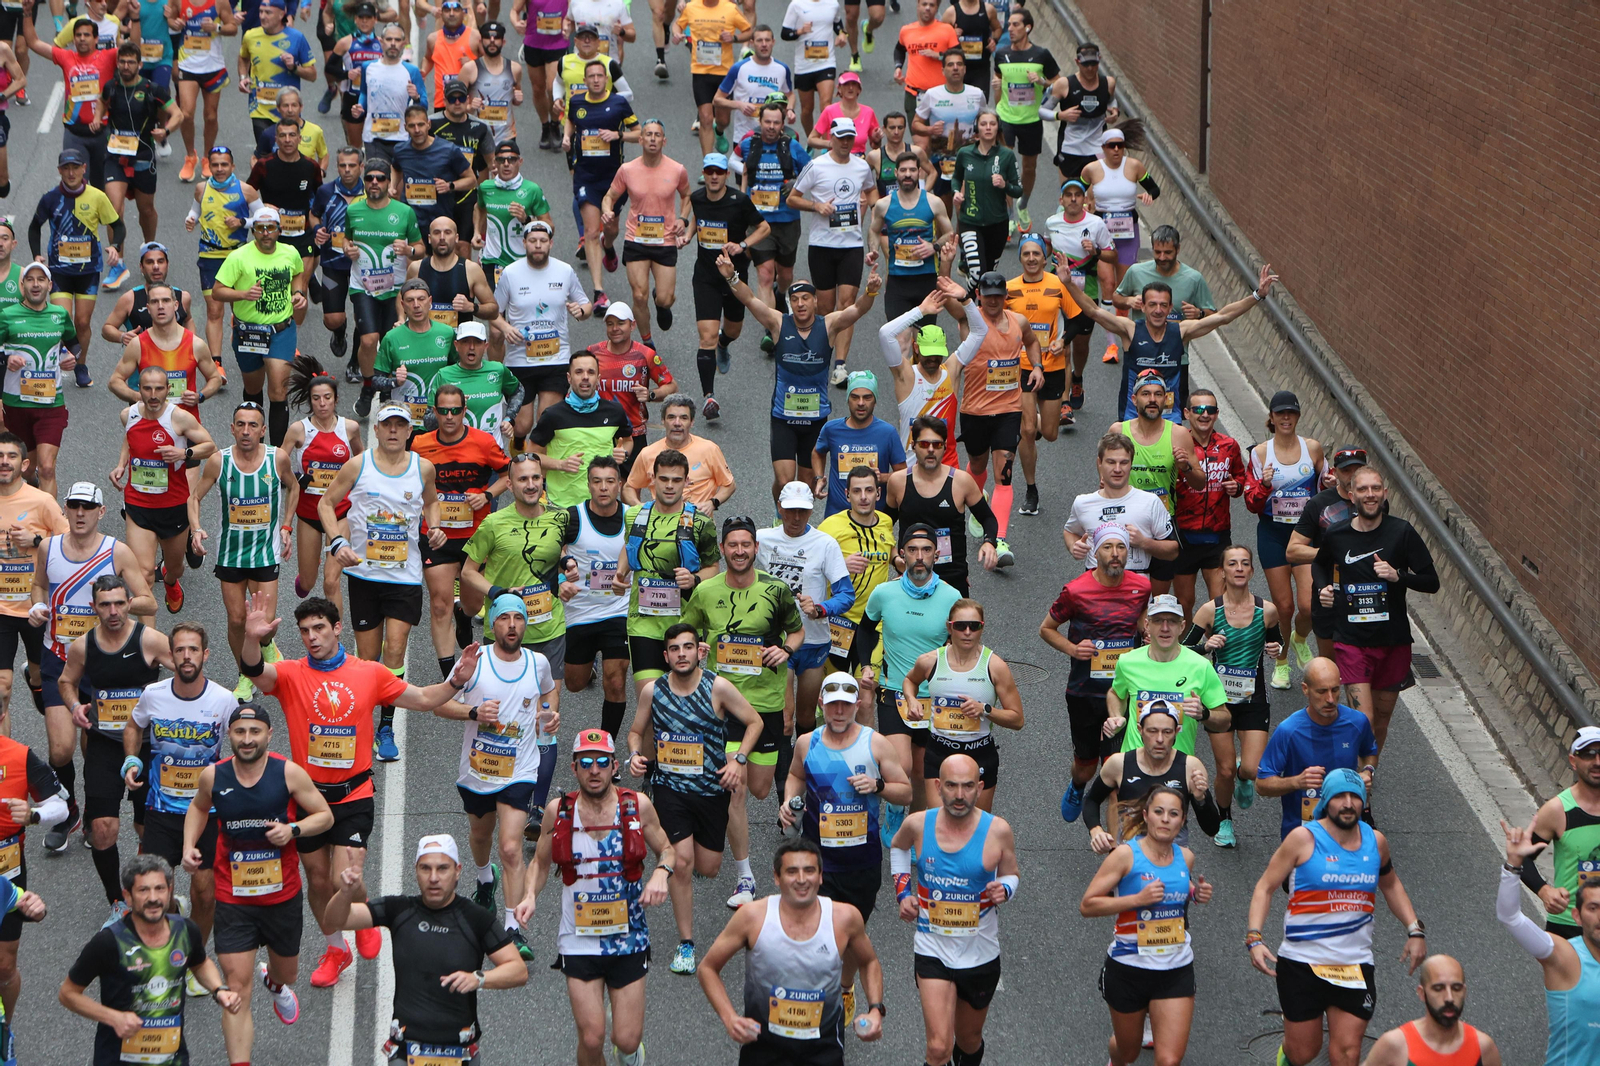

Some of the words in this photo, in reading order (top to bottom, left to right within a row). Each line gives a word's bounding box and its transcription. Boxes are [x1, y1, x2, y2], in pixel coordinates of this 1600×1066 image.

[967, 180, 977, 217] Fysical
[537, 331, 556, 339] ZURICH
[525, 584, 547, 595] ZURICH
[1107, 640, 1130, 648] ZURICH
[1228, 668, 1252, 676] ZURICH
[1225, 680, 1243, 688] 10145
[110, 690, 137, 698] ZURICH
[672, 734, 698, 742] ZURICH
[320, 751, 343, 759] ANDRÉS
[484, 746, 512, 756] ZURICH
[671, 747, 687, 755] 4831
[482, 758, 499, 766] 4380
[246, 851, 274, 860] ZURICH
[246, 867, 264, 875] 4980
[924, 873, 969, 887] enerplus
[1322, 873, 1376, 884] enerplus
[945, 892, 975, 901] ZURICH
[1328, 891, 1368, 900] Maratón
[592, 908, 610, 916] 5296
[1154, 909, 1180, 918] ZURICH
[1154, 926, 1171, 934] 3885
[789, 991, 820, 1001] ZURICH
[787, 1007, 806, 1016] 4186
[144, 1018, 175, 1027] ZURICH
